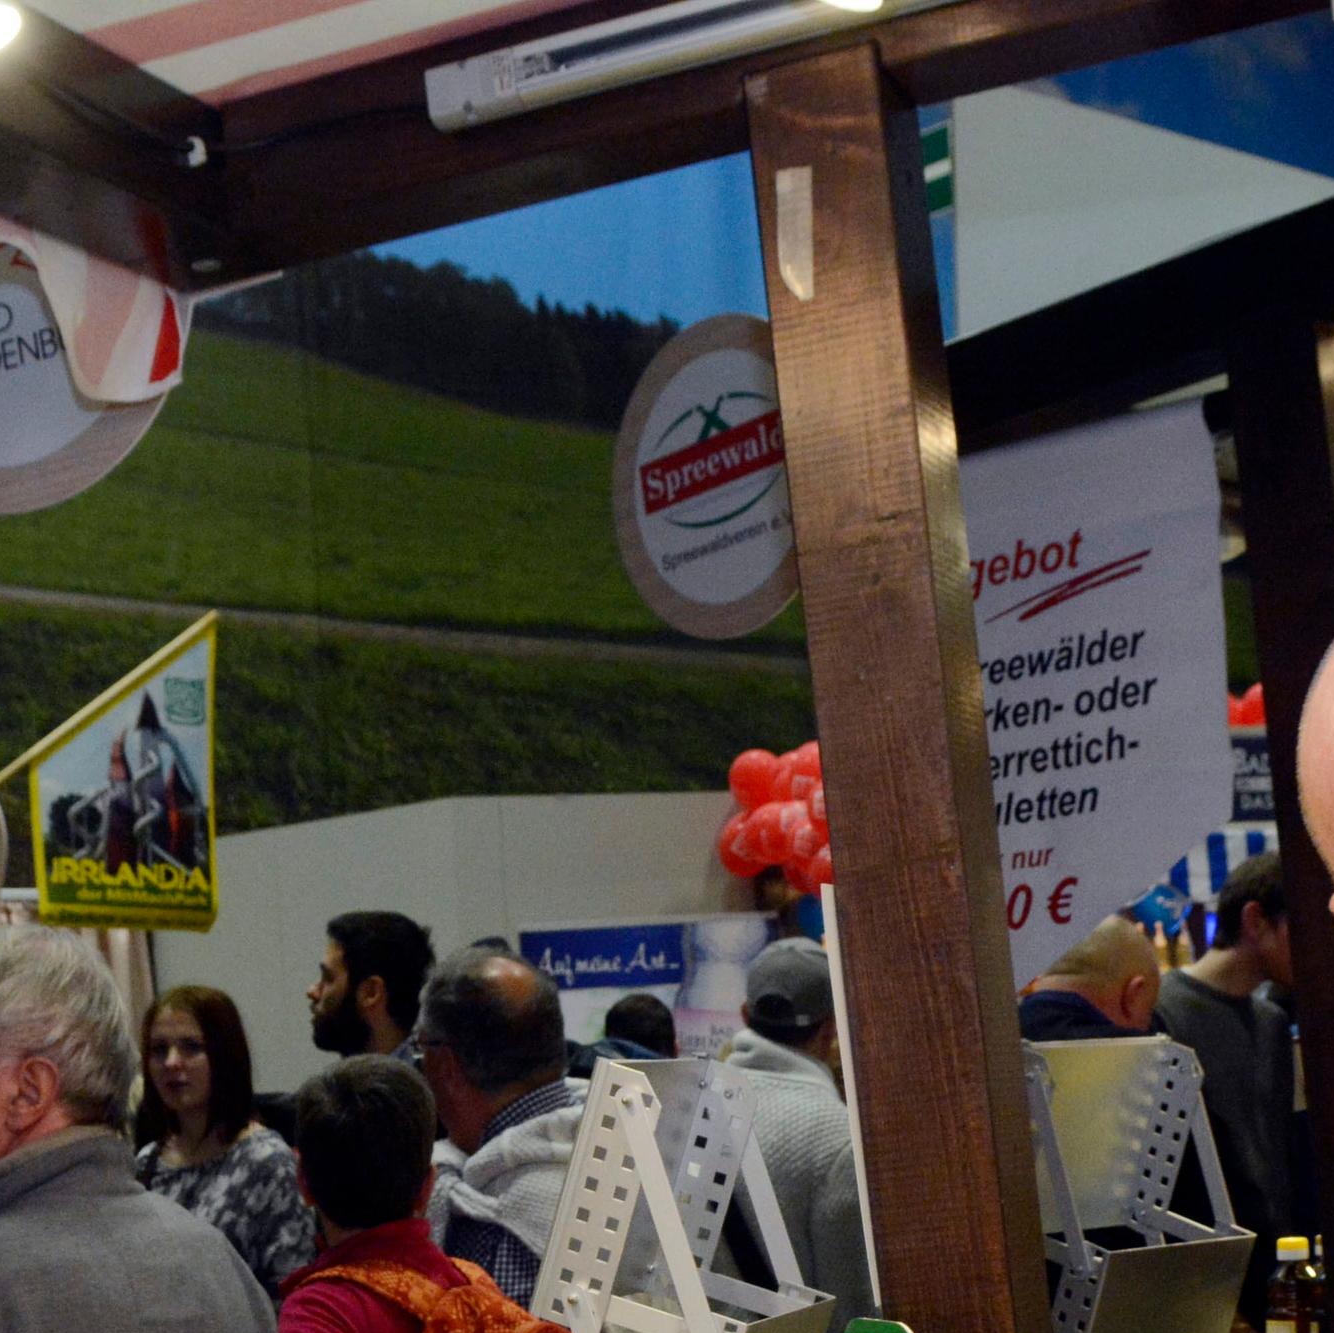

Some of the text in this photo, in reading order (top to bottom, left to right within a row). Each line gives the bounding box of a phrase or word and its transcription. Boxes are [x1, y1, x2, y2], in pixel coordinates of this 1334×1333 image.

[969, 528, 1083, 600] gebot
[980, 626, 1147, 685] eewälder
[983, 675, 1158, 735] ken- oder
[988, 726, 1140, 781] errettich-
[994, 785, 1100, 826] letten
[50, 855, 210, 892] IRRLANDIA
[1011, 846, 1055, 870] nur
